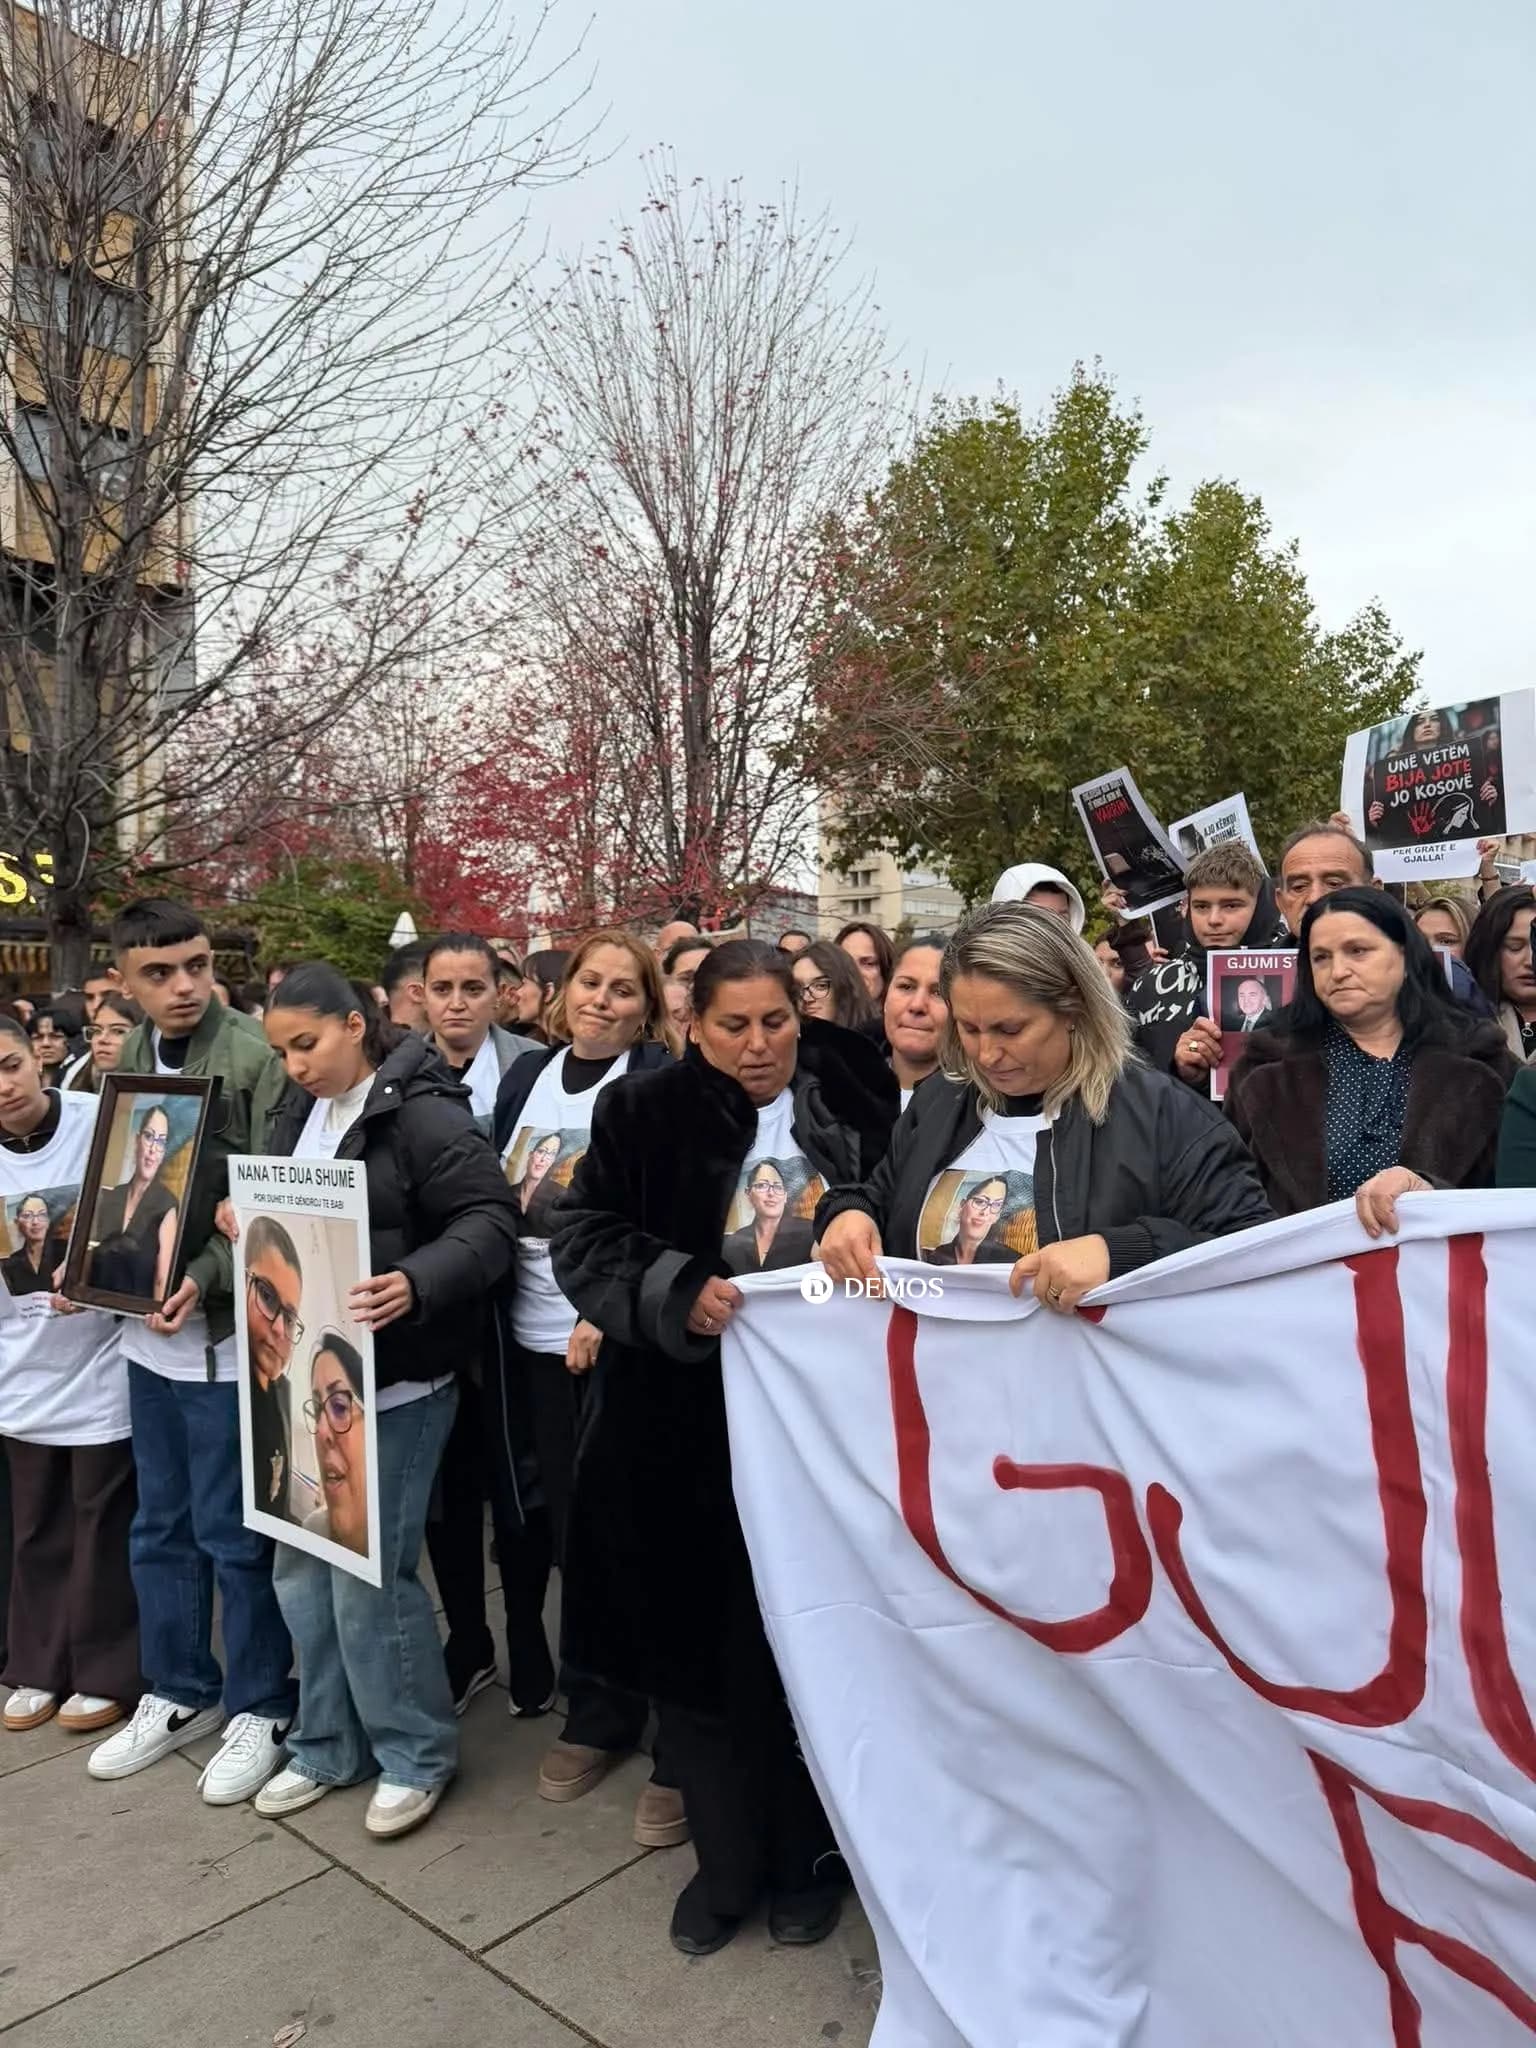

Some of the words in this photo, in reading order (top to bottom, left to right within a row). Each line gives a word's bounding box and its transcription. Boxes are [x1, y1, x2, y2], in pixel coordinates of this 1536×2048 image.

[1388, 753, 1418, 774] UNË
[1423, 743, 1470, 765] VETËM
[1384, 768, 1426, 792] BIJA
[1432, 758, 1472, 781] JOTE
[1390, 789, 1410, 808] JO
[1414, 772, 1474, 801] KOSOVË
[1204, 823, 1216, 837] AJO
[1215, 811, 1237, 831] KËRKOI
[1226, 957, 1279, 970] GJUMI
[1282, 956, 1298, 969] S
[237, 1163, 270, 1181] NANA
[272, 1165, 287, 1183] TE
[288, 1166, 314, 1185] DUA
[315, 1166, 356, 1189] SHUMË
